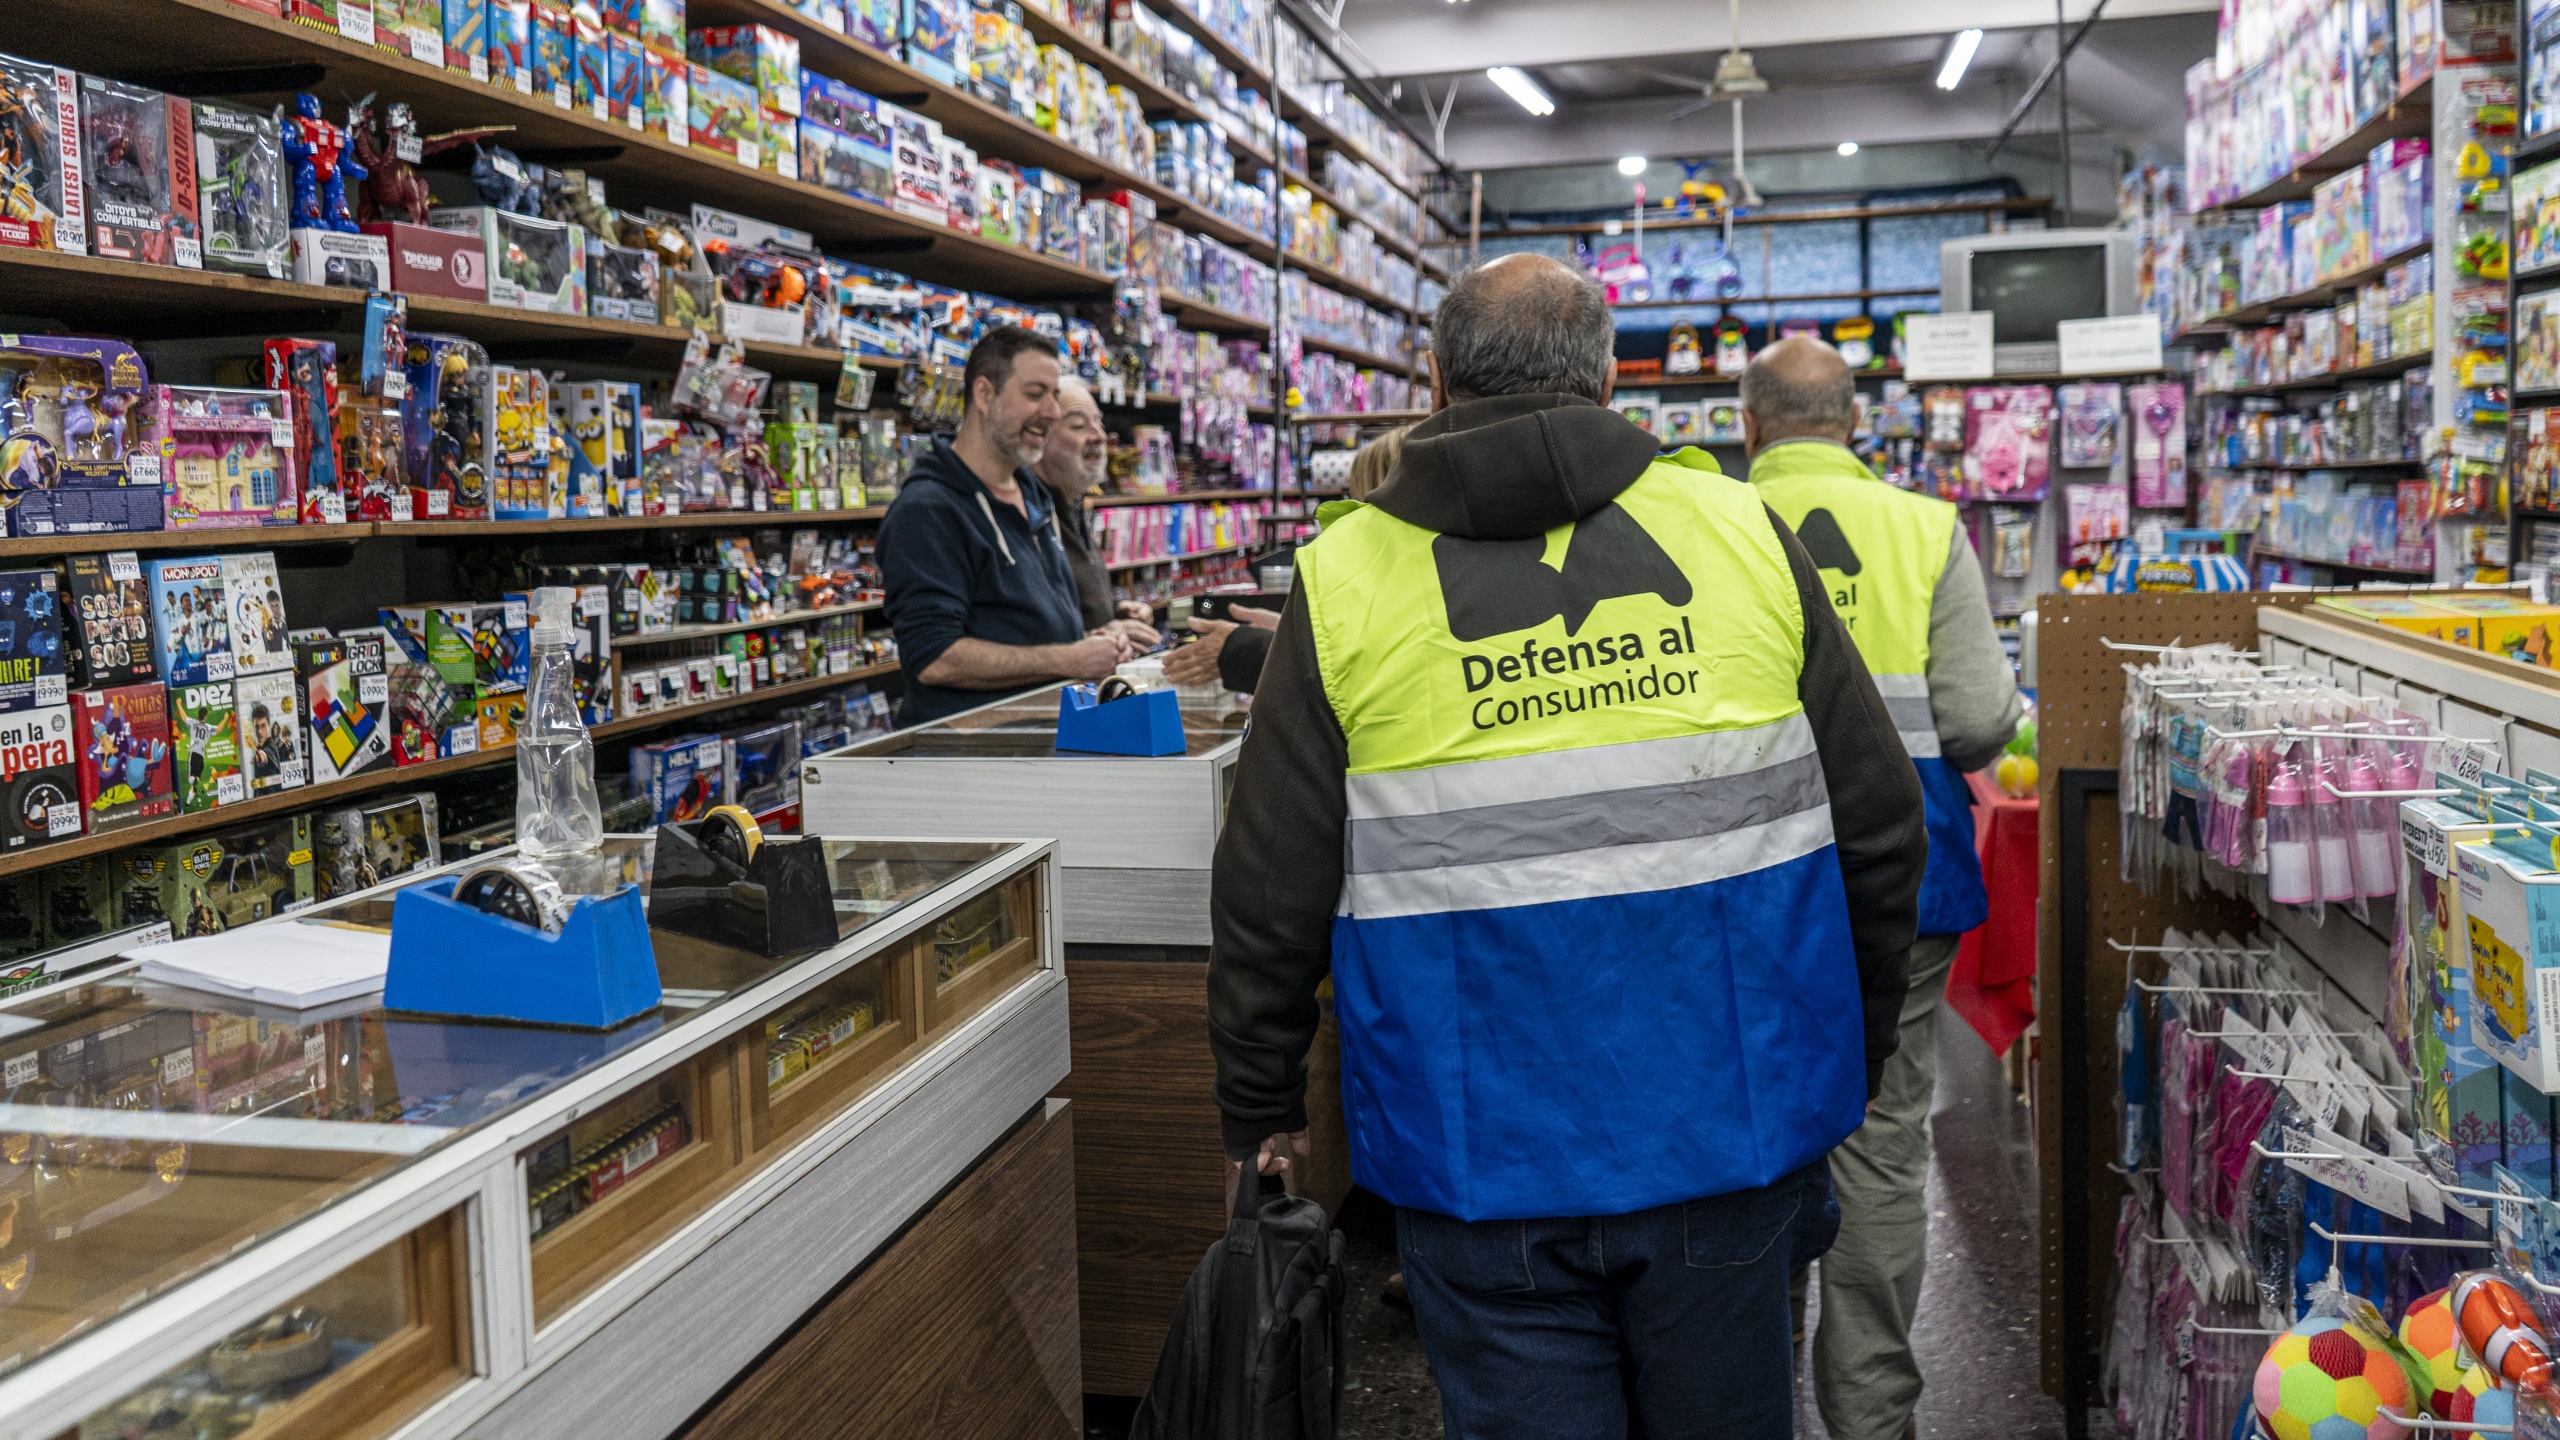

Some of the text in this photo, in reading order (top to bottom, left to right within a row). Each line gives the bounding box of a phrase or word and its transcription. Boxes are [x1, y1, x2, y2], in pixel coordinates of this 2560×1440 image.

[200, 119, 255, 134] CONVERTIBLES
[208, 113, 235, 123] DITOYS
[60, 102, 81, 217] LATEST SERIES
[172, 102, 192, 212] D-SOLDIER
[105, 203, 137, 217] DITOYS
[96, 212, 162, 231] CONVERTIBLES
[57, 230, 84, 245] 22.900
[402, 250, 444, 269] DINOSAUR
[163, 566, 218, 581] MONOPOLY
[1835, 583, 1857, 607] al
[312, 648, 342, 665] RUBIK'S
[348, 643, 380, 660] GRID
[1462, 616, 1696, 693] Defensa al
[350, 658, 382, 673] LOCK
[1472, 663, 1700, 731] Consumidor
[1, 722, 44, 747] en la
[195, 727, 206, 740] 10
[2, 739, 69, 783] pera
[193, 853, 210, 864] ELITE
[195, 862, 211, 870] FORCE
